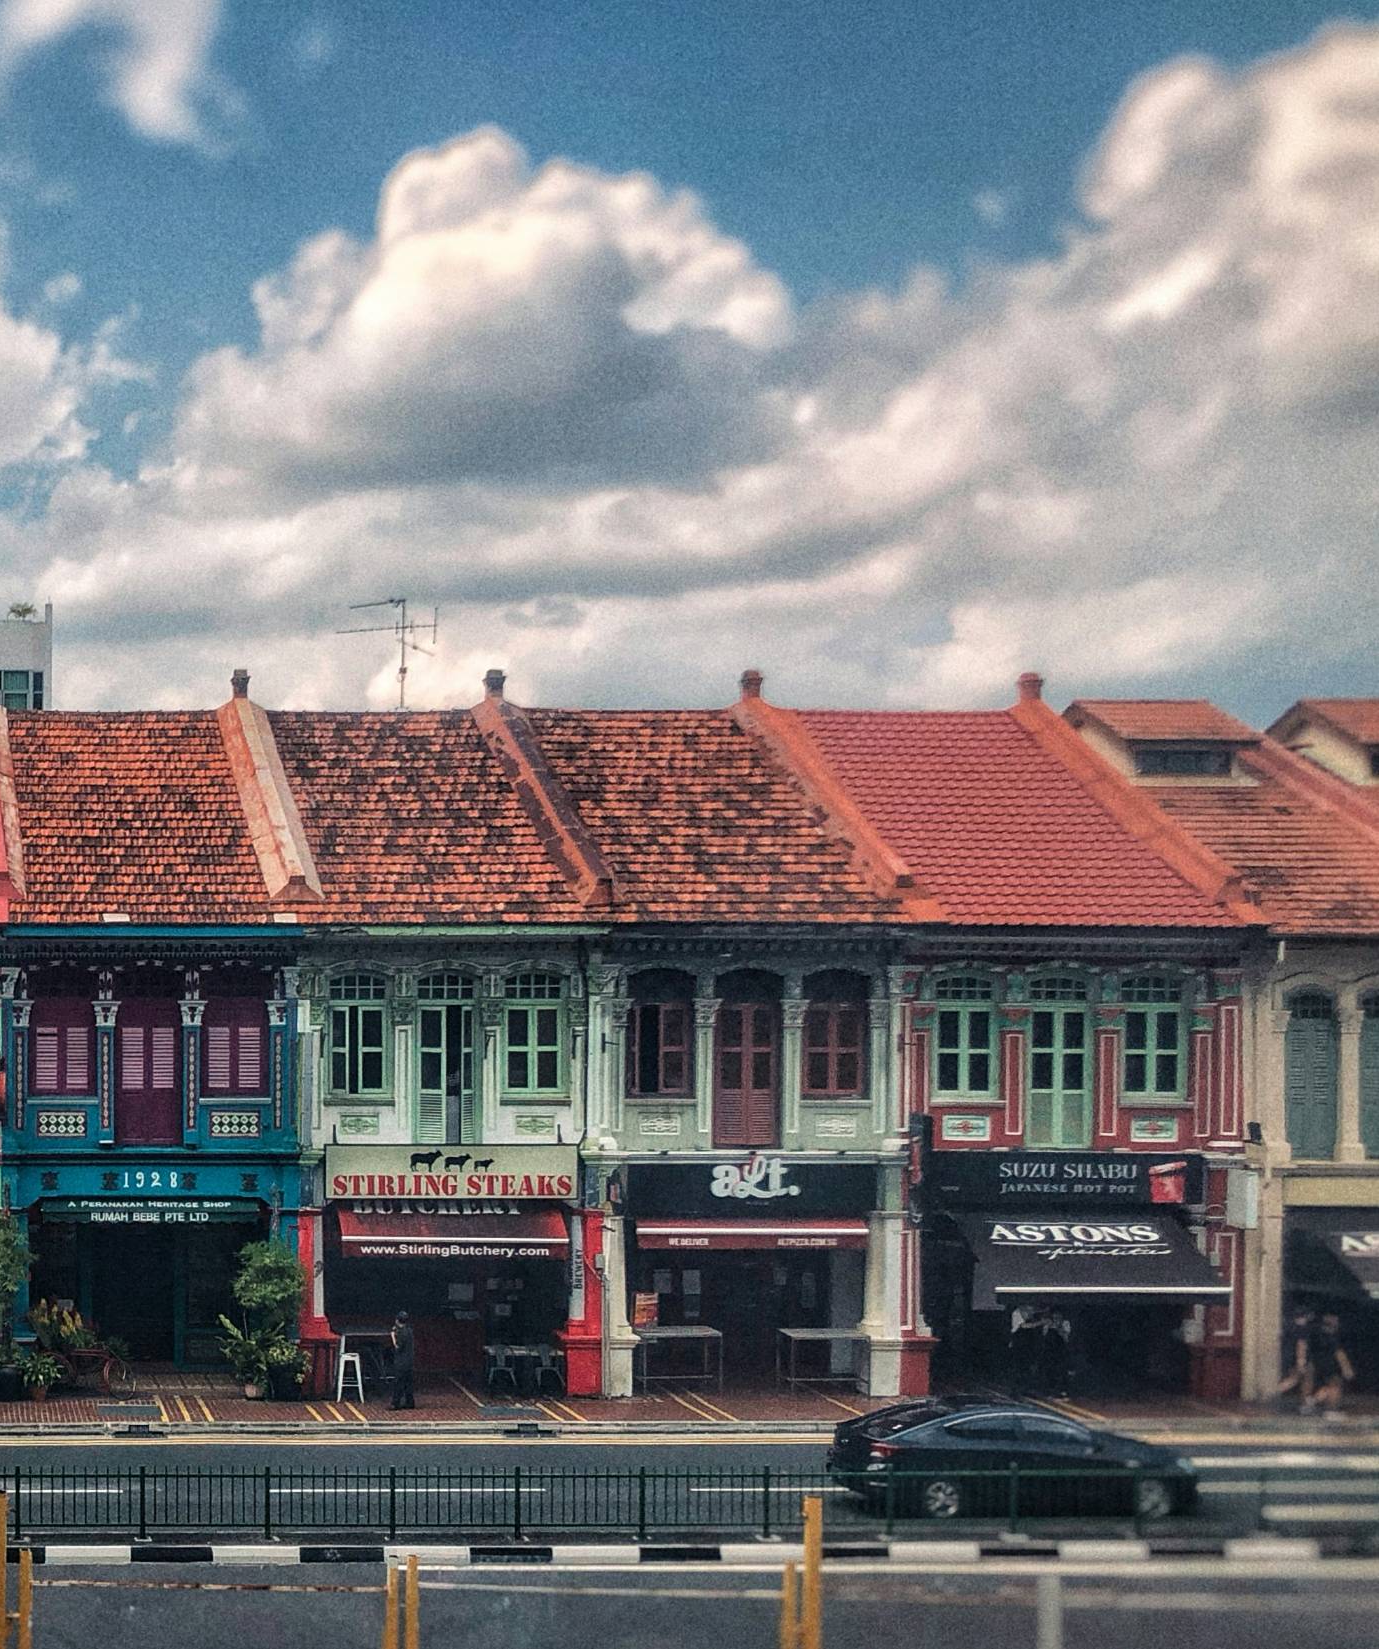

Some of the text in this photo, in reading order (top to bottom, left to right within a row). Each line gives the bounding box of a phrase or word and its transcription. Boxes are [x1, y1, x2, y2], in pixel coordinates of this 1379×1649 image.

[999, 1162, 1138, 1179] SUZU SHABU
[122, 1171, 178, 1188] 1928
[332, 1174, 572, 1196] STIRLING STEAKS
[1000, 1183, 1137, 1194] JAPANESE HOT POT
[91, 1212, 209, 1222] RUMAH BEBE PTE LTD
[990, 1224, 1159, 1241] ASTONS
[360, 1243, 549, 1257] www.StirlingButchery.com
